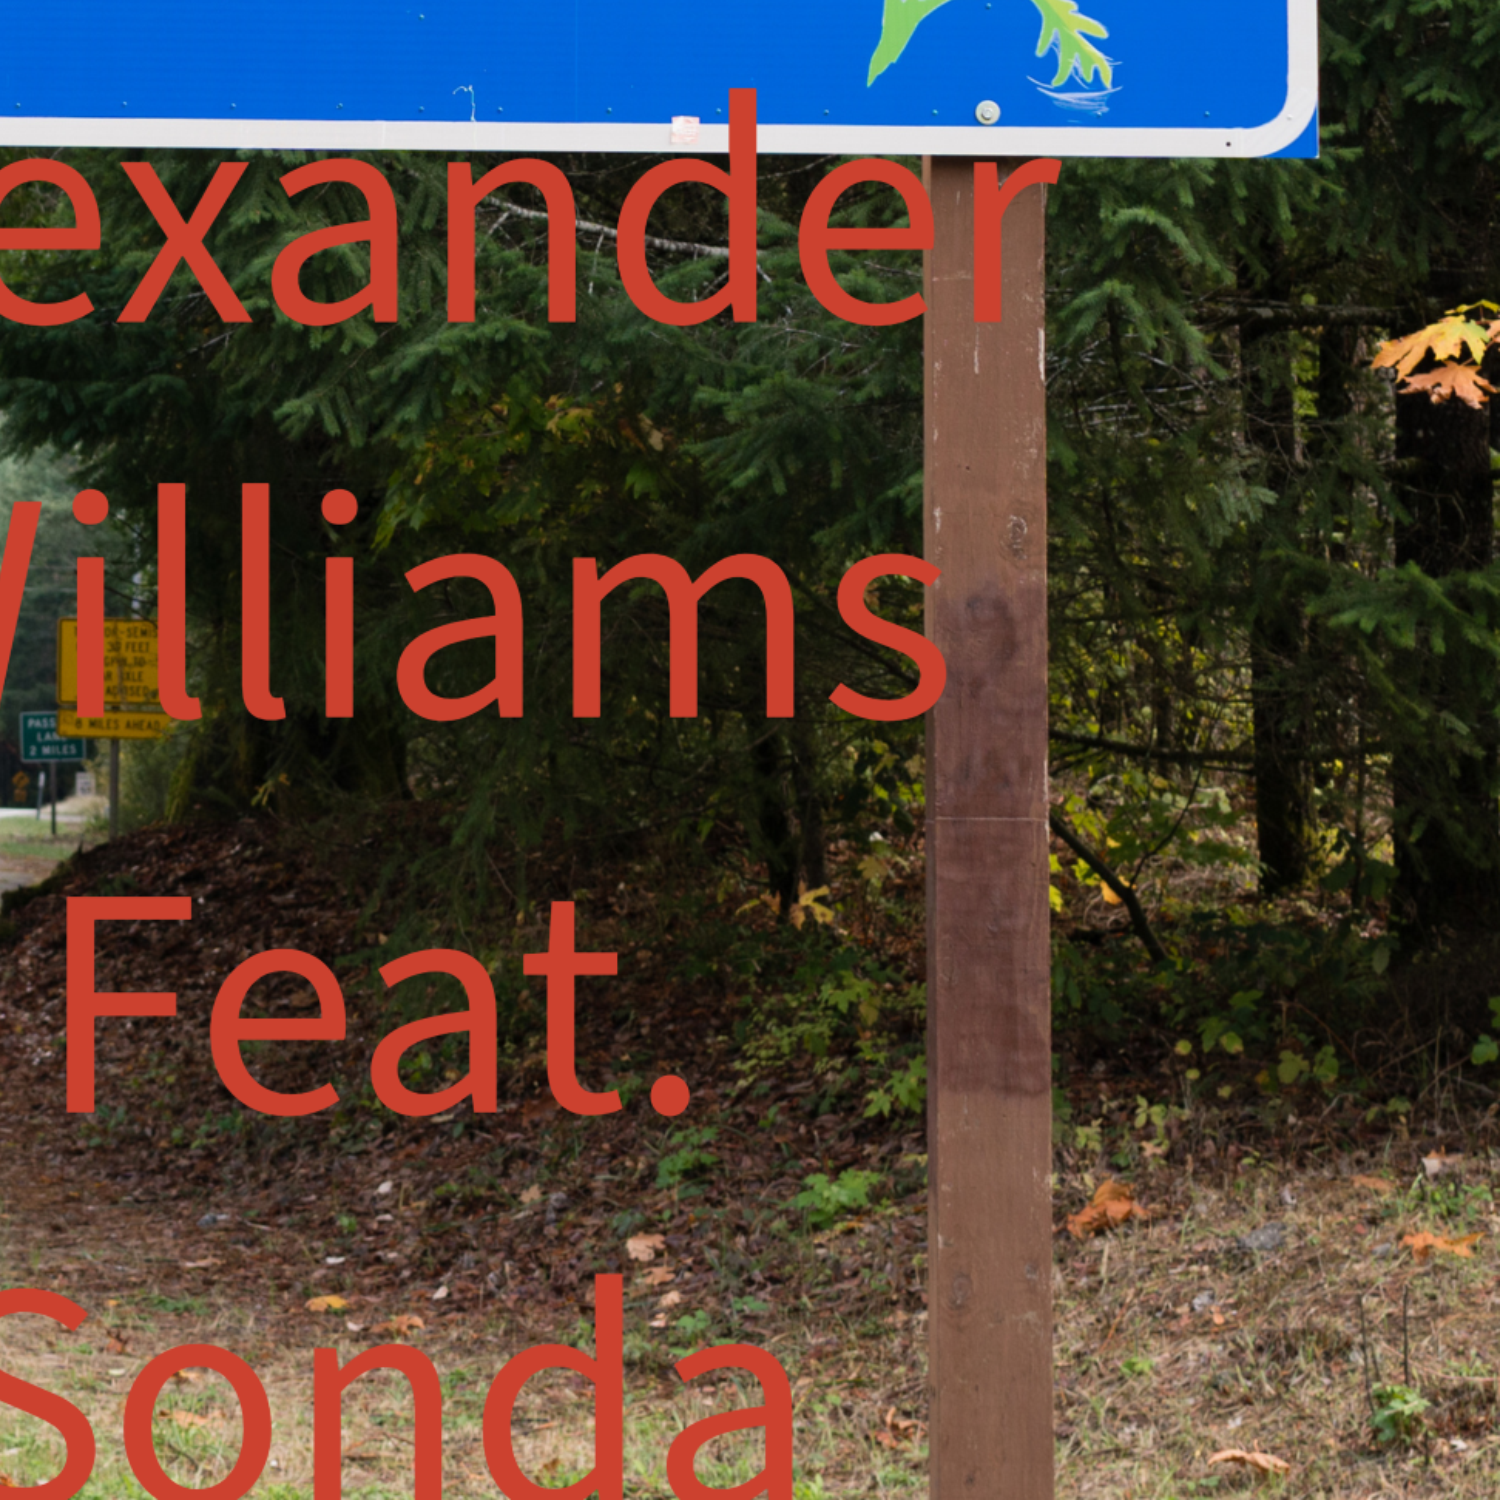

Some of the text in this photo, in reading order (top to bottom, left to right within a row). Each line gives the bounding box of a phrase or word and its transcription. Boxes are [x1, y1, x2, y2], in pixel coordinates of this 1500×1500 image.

[125, 641, 150, 653] FEET
[27, 717, 57, 729] PASS
[89, 718, 120, 731] MILES
[125, 719, 161, 732] AHEAD
[29, 744, 77, 757] 2 MILES
